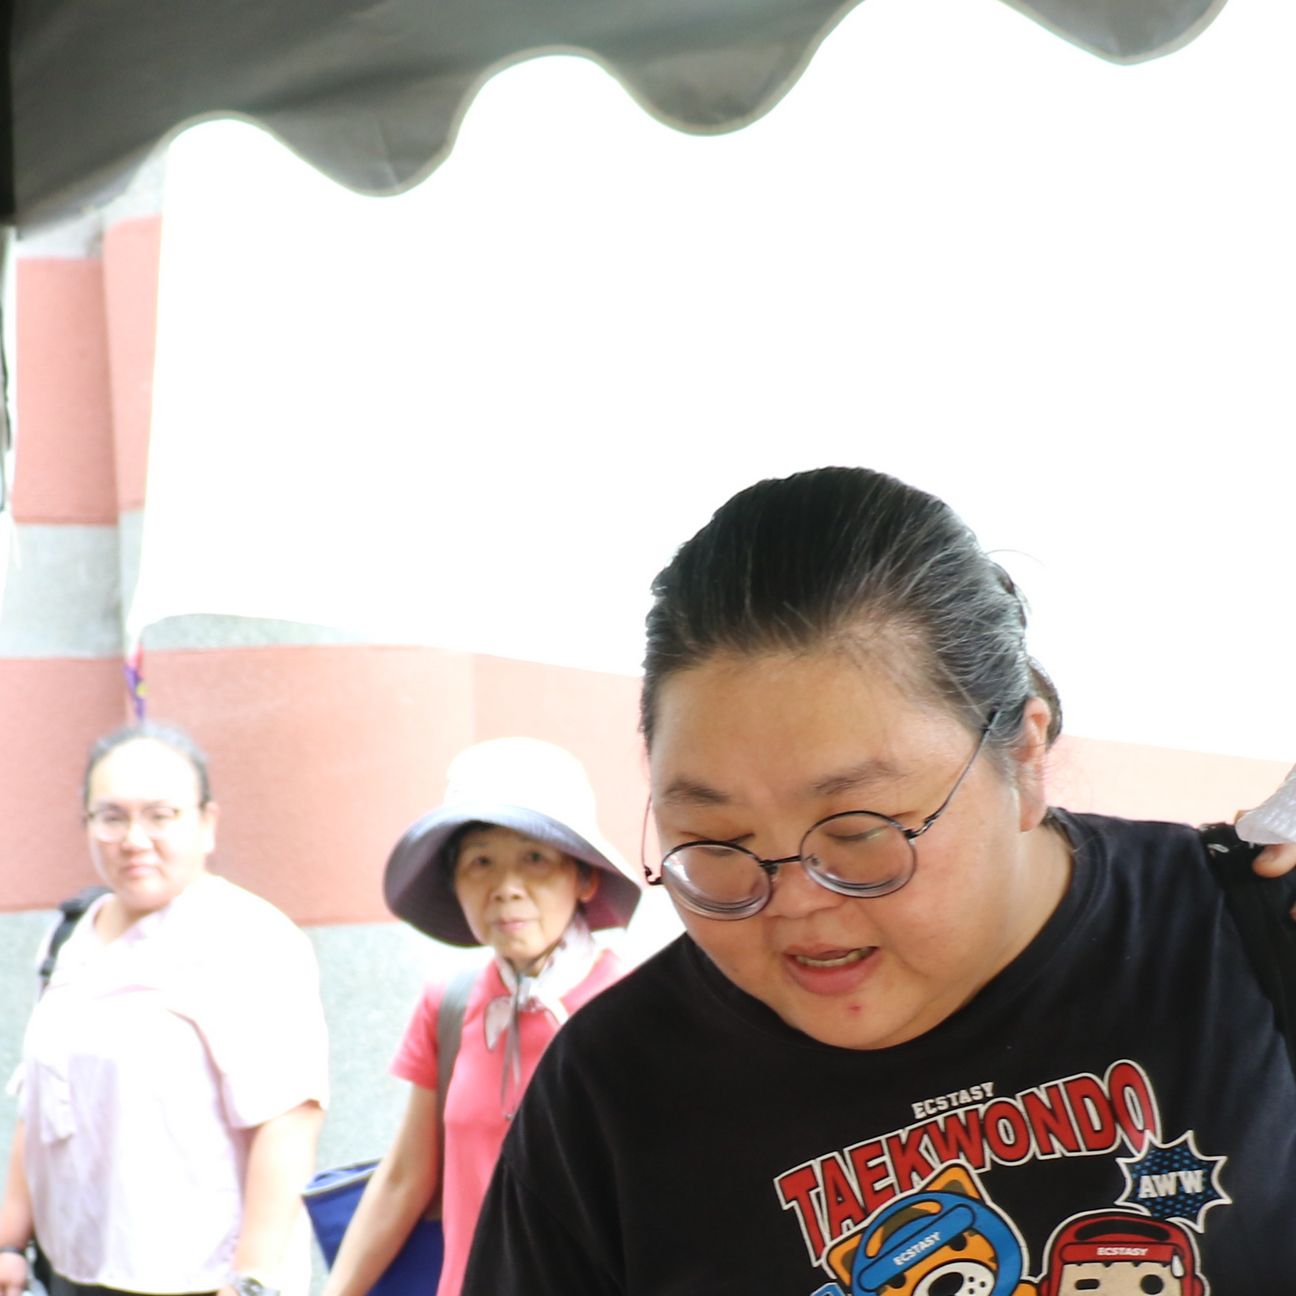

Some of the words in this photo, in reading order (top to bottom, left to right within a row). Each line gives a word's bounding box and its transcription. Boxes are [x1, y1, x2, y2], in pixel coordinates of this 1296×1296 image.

[911, 1082, 995, 1119] ECSTASY
[774, 1060, 1160, 1267] TAEKWONDO
[1139, 1169, 1205, 1199] AWW
[893, 1231, 942, 1267] ECSTASY
[1096, 1246, 1148, 1258] ECSTASY
